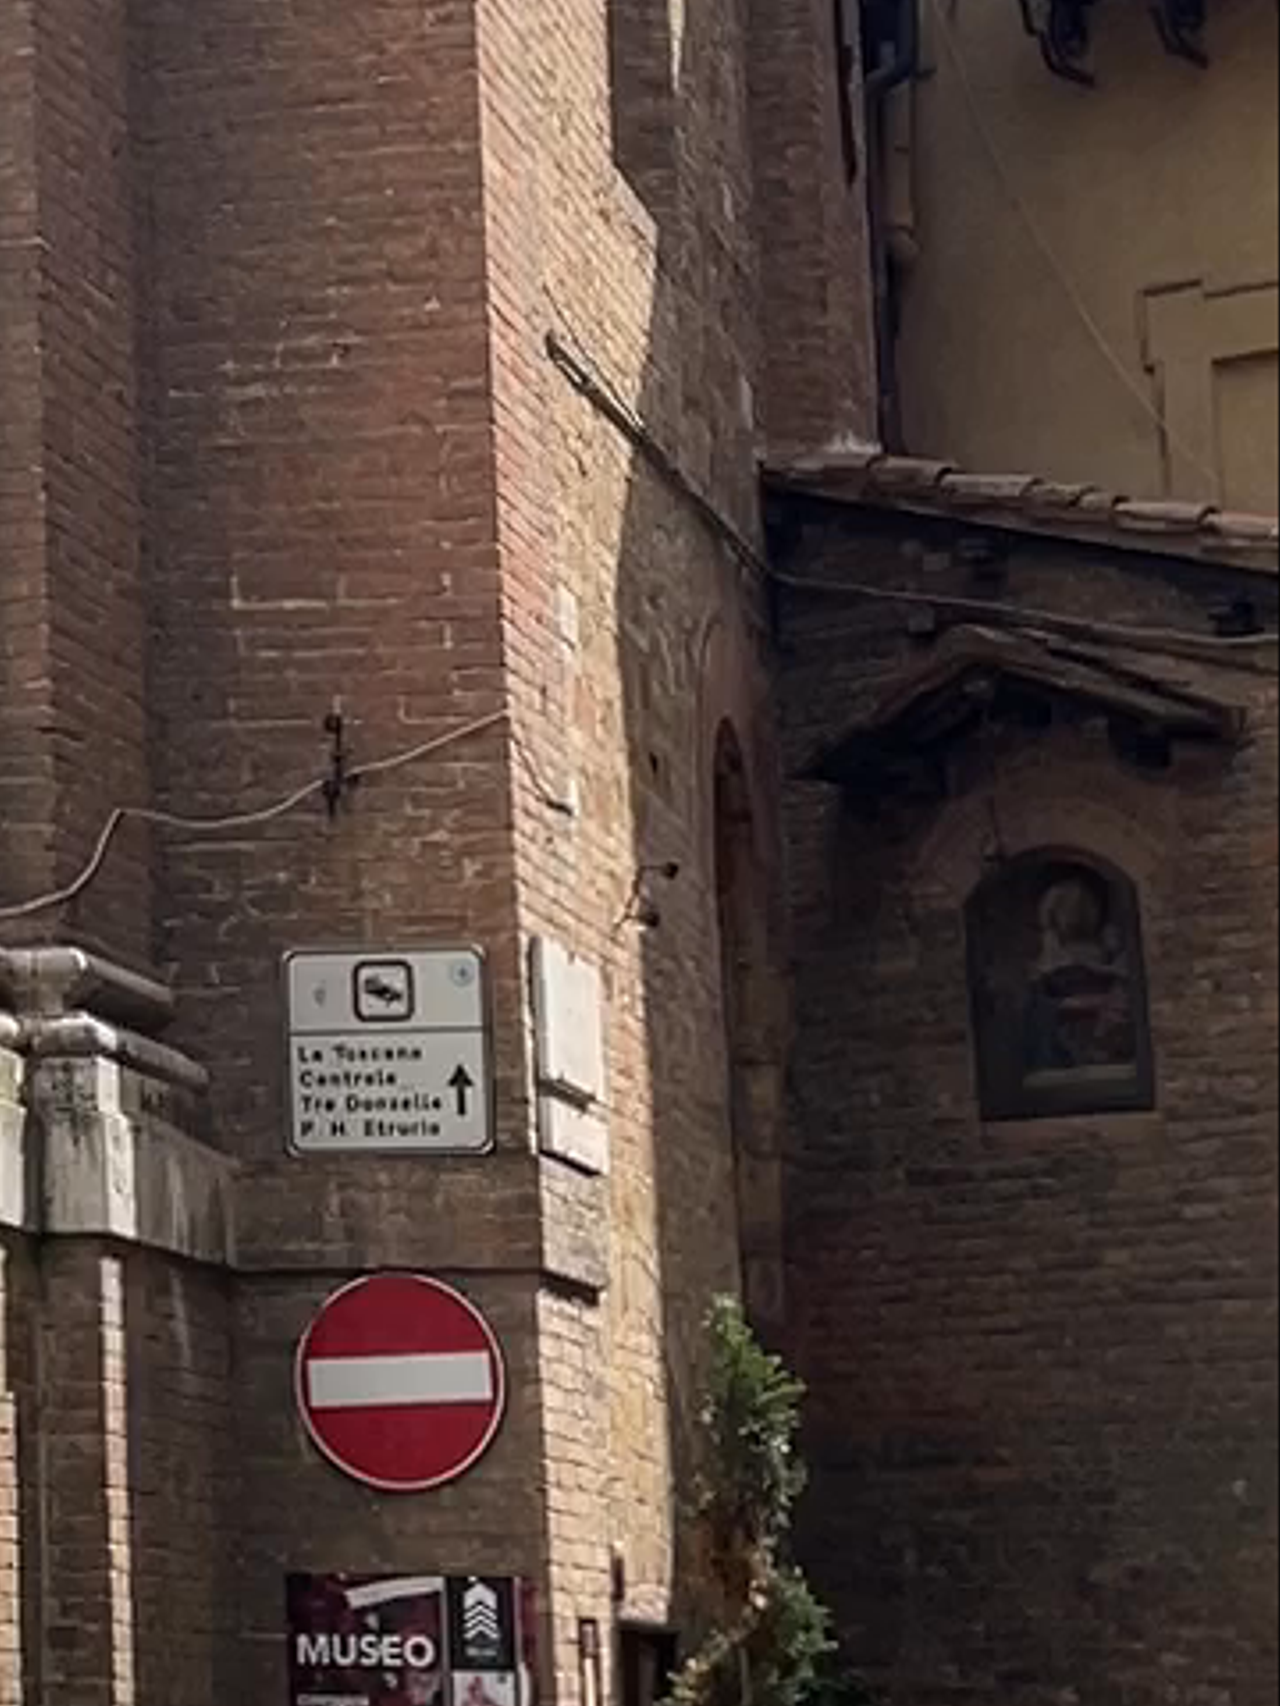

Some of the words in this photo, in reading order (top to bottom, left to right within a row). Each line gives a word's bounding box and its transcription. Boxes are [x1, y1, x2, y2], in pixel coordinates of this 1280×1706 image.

[297, 1045, 324, 1065] La
[331, 1043, 423, 1064] Toscana
[299, 1069, 396, 1089] Centrale
[300, 1094, 337, 1115] Tre
[363, 1116, 442, 1138] Etruria
[295, 1631, 436, 1669] MUSEO
